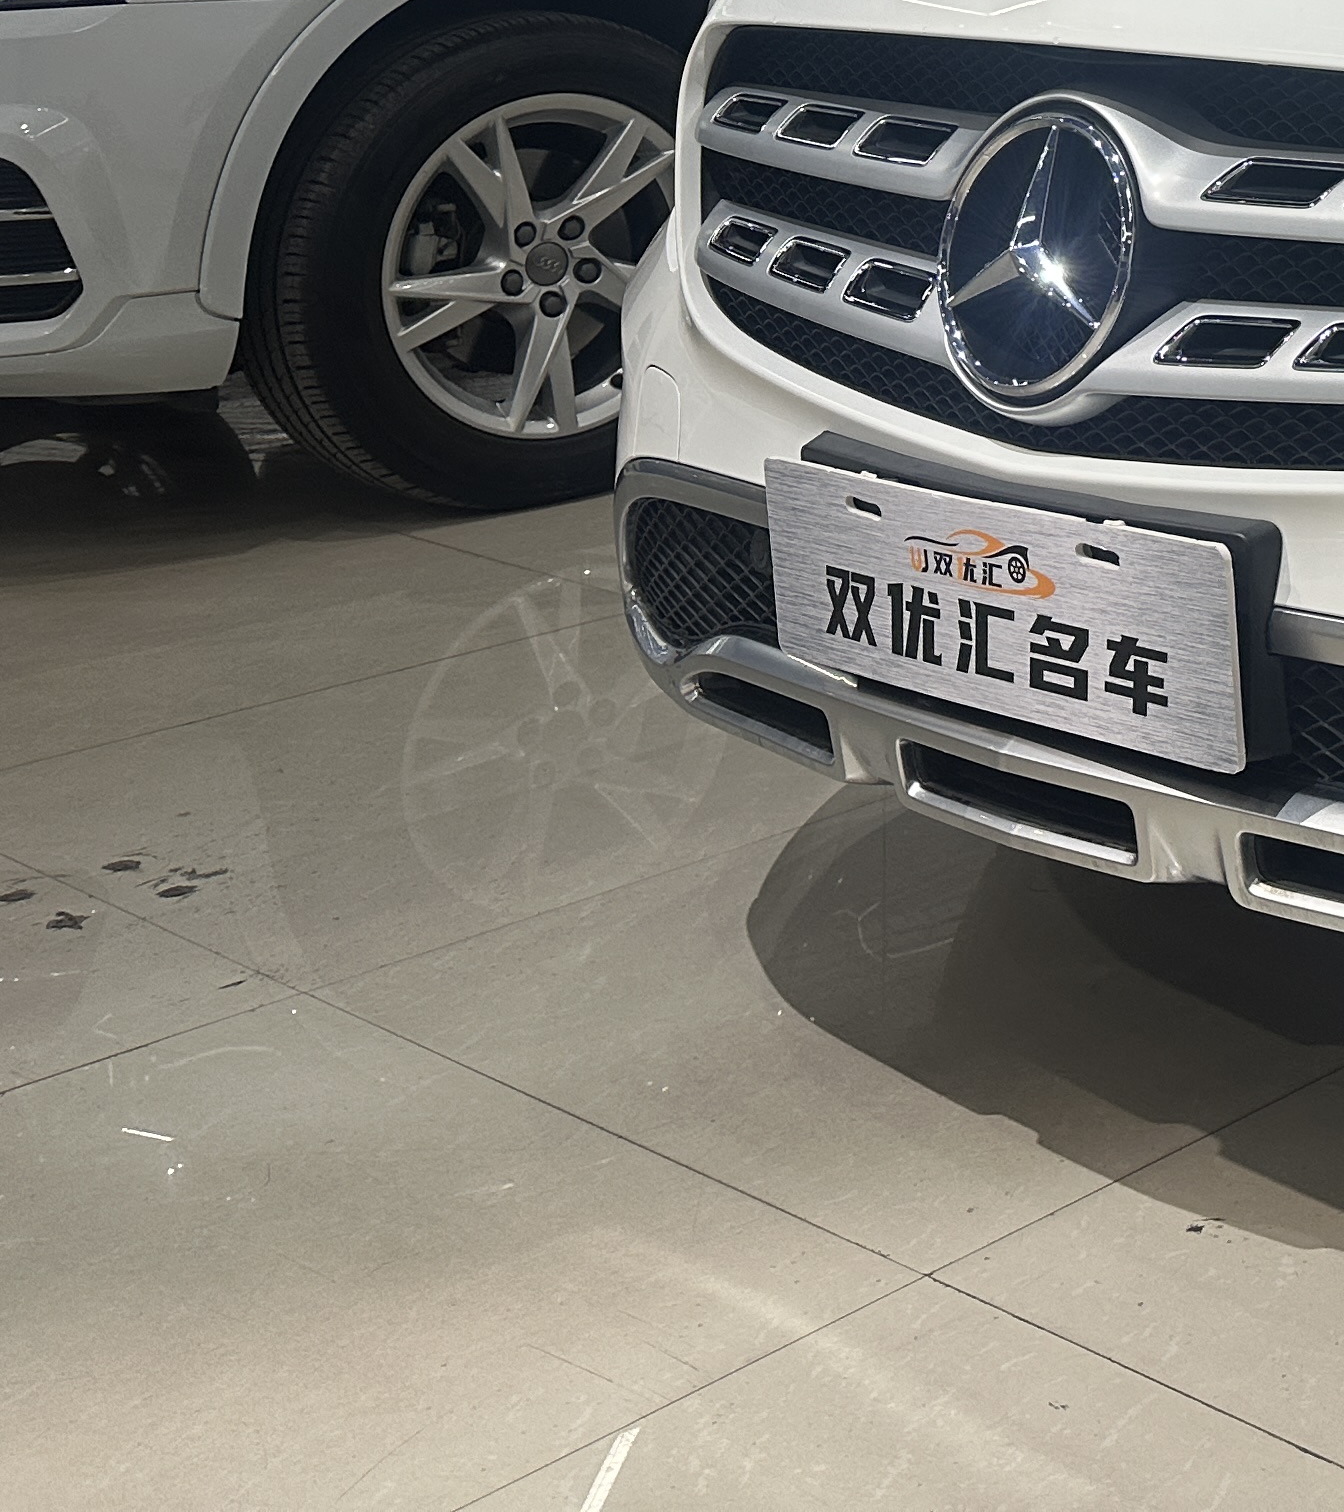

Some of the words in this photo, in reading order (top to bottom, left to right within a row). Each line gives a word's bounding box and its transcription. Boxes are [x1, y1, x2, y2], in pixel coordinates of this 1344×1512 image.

[825, 564, 1169, 717] 双优汇名车
